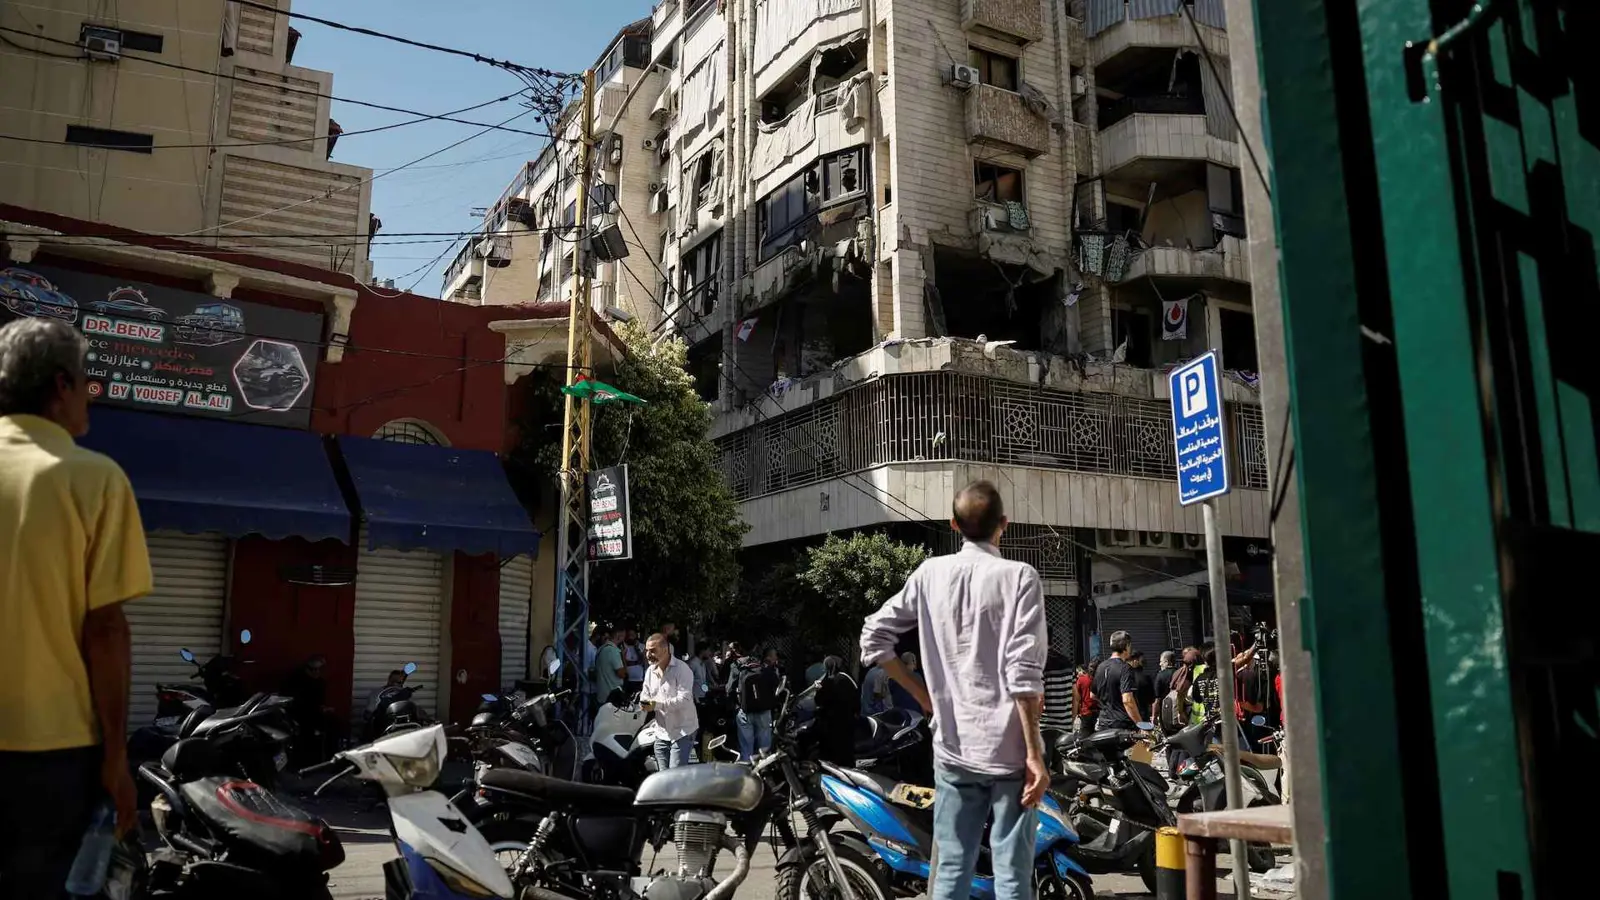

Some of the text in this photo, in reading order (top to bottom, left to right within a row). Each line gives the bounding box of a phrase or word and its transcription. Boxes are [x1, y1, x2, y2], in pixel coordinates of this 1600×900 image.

[85, 318, 162, 339] DR.BENZ
[99, 353, 117, 365] زيت
[118, 355, 140, 367] غيار
[125, 372, 166, 385] مستعمل
[176, 379, 203, 390] جديدة
[111, 385, 128, 396] BY
[135, 387, 181, 402] YOUSEF
[205, 383, 228, 392] قطع
[1185, 372, 1200, 411] P
[1177, 414, 1219, 439] موقف إسعاف
[1200, 435, 1219, 449] جمعية
[1202, 447, 1222, 465] الخيرية
[1190, 466, 1213, 483] في بيروت
